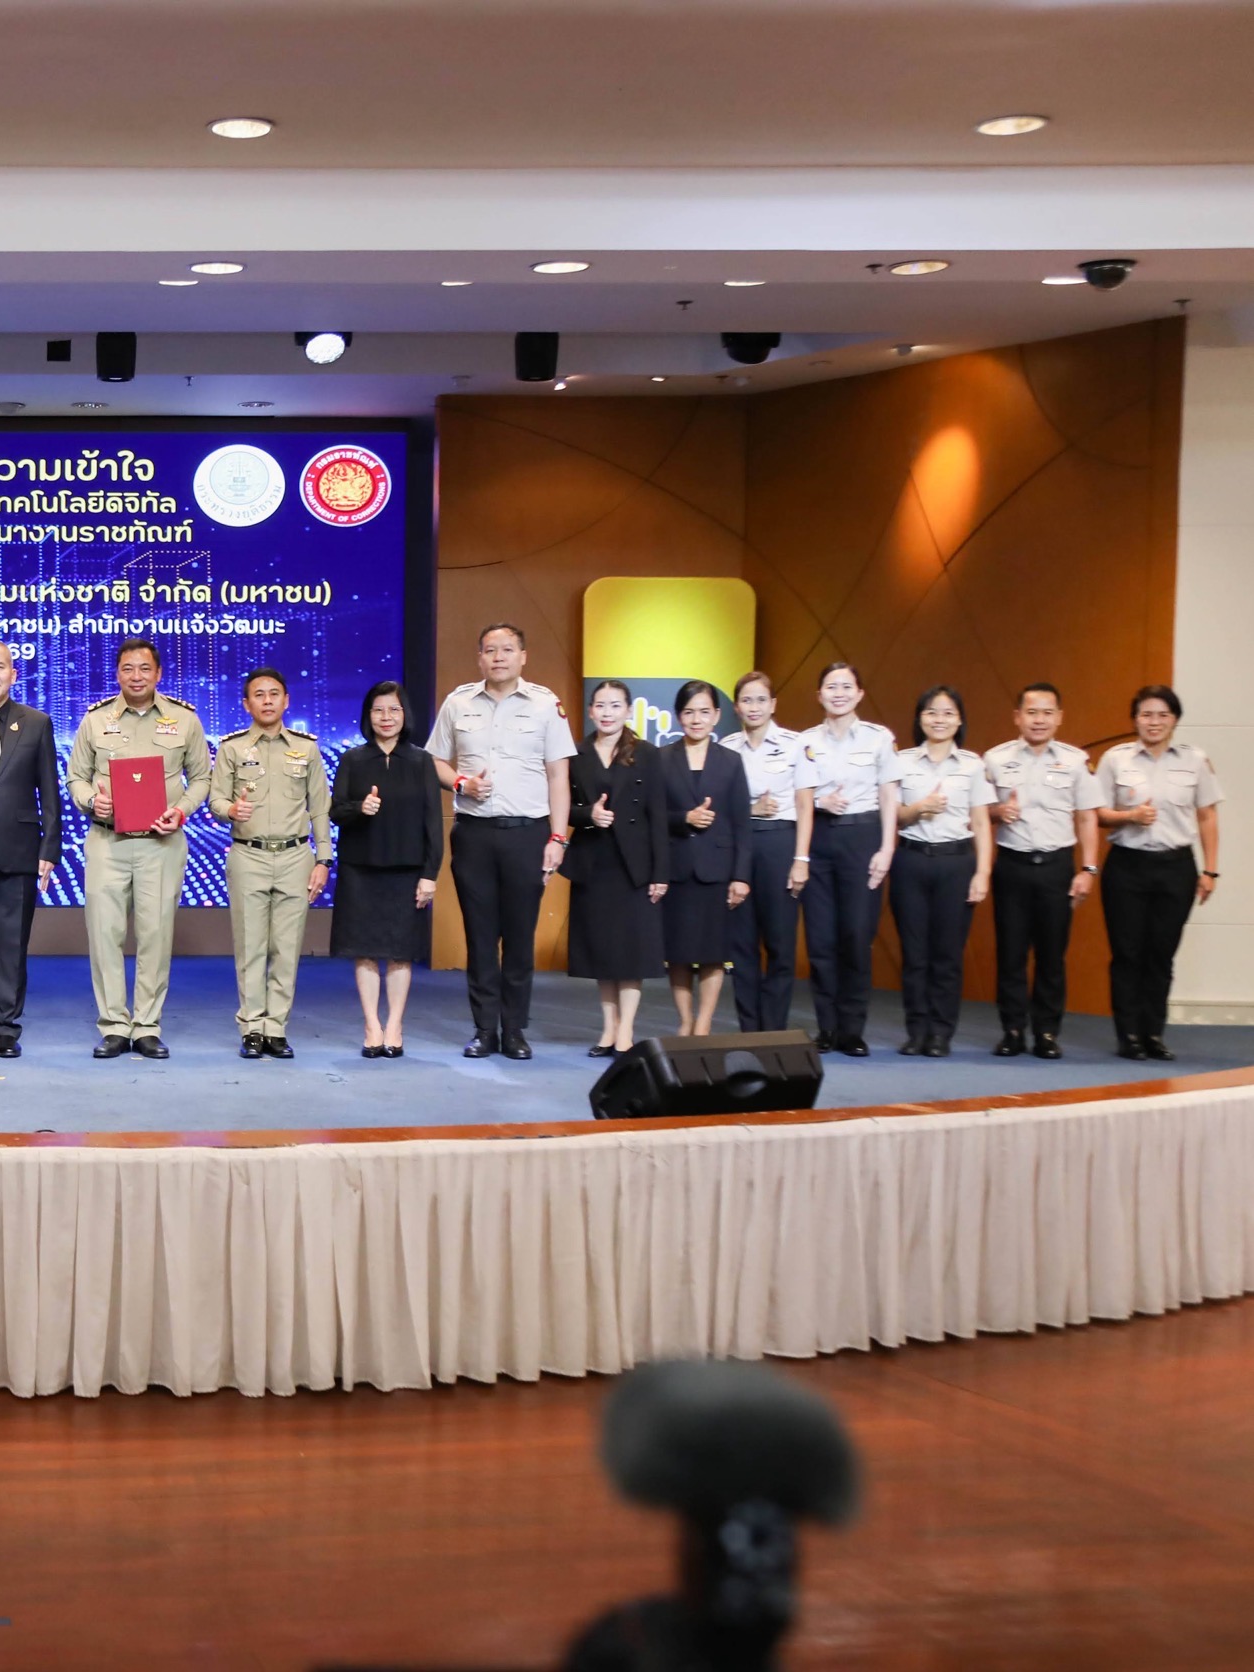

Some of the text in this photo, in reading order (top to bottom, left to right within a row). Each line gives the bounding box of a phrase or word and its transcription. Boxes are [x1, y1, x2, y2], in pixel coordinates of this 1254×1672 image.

[197, 484, 282, 522] กระทรวงยุติธรรม
[305, 482, 336, 522] DEPARTMENT
[351, 482, 386, 522] CORRECTIONS
[139, 577, 211, 603] จำกัด
[220, 581, 331, 606] (มหาชน)
[68, 613, 286, 635] สำนักงานแจ้งวัฒนะ
